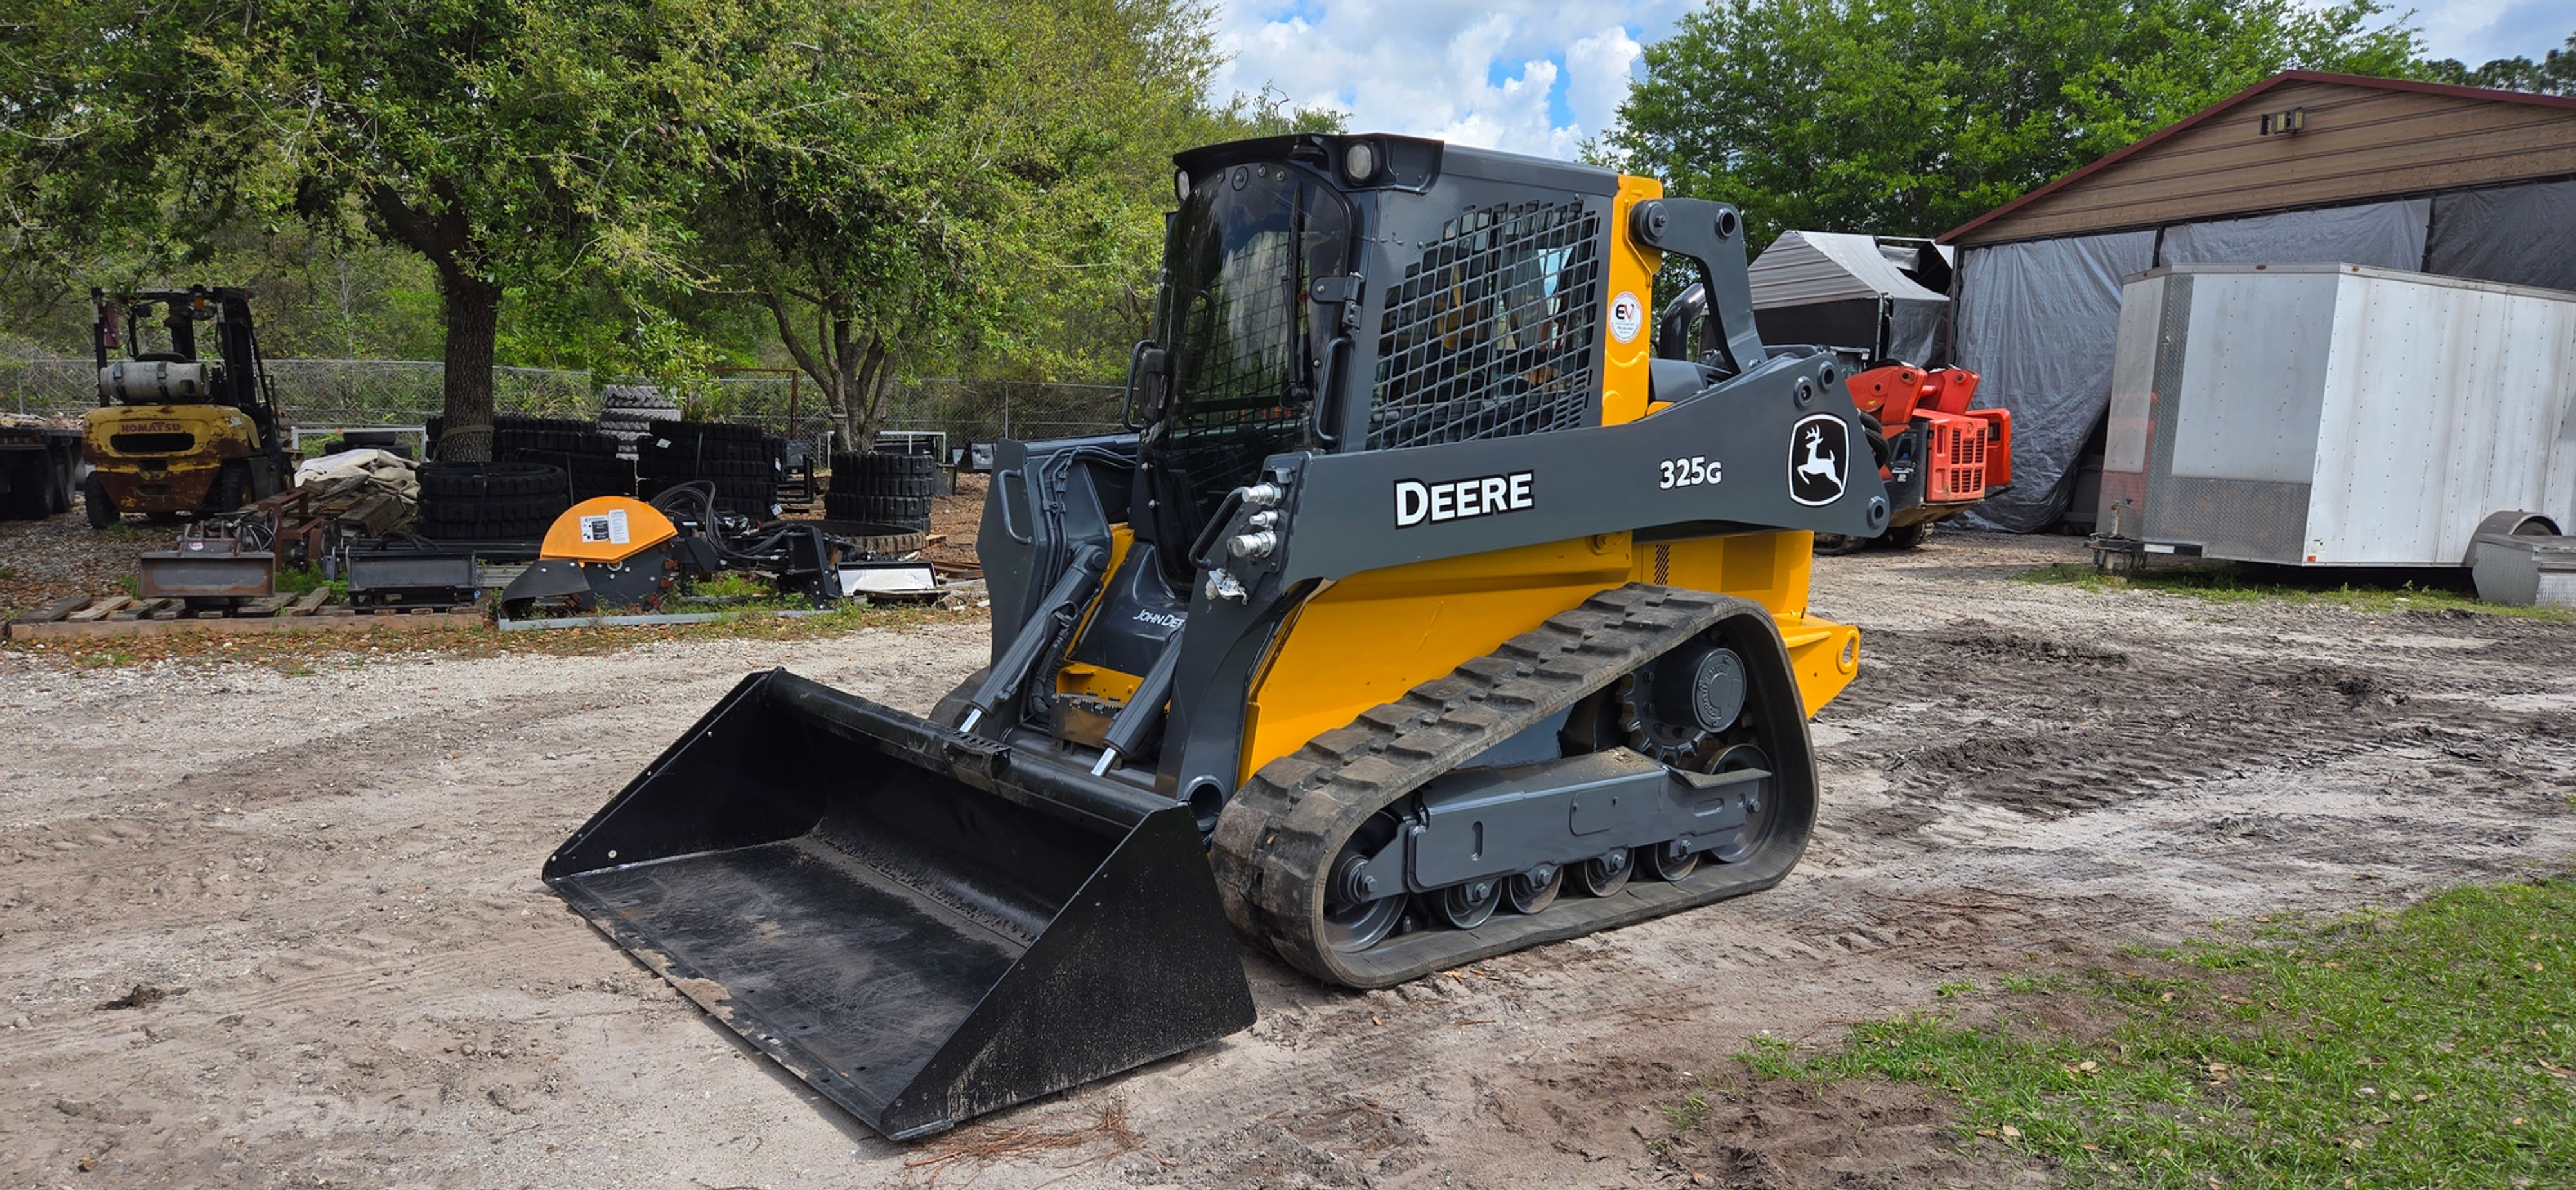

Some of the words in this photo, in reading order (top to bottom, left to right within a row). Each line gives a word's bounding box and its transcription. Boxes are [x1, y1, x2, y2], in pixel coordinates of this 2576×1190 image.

[1615, 303, 1634, 320] EV
[121, 422, 182, 433] KOMATSU
[1660, 455, 1722, 489] 325G
[1394, 470, 1533, 528] DEERE
[1133, 609, 1164, 625] JOHN
